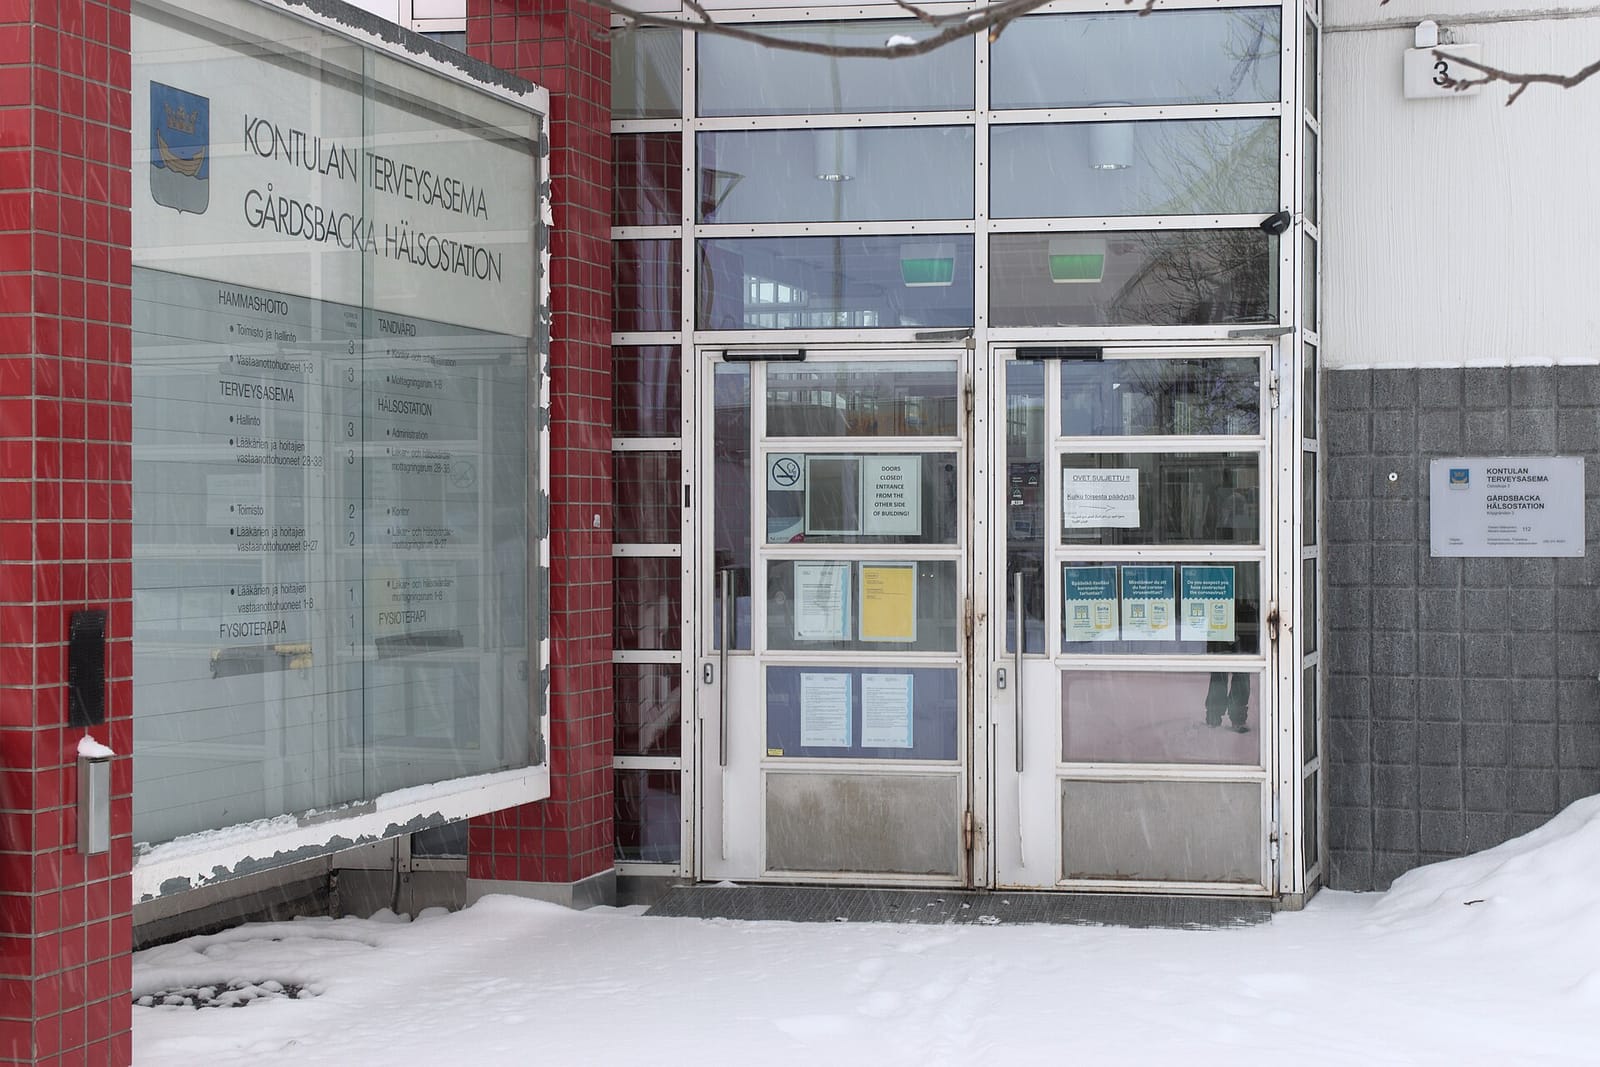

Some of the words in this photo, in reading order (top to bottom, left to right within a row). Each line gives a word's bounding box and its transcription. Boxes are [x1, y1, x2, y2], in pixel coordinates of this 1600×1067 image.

[1433, 61, 1449, 86] 3
[244, 114, 357, 183] KONTULAN
[366, 151, 488, 221] TERVEYSASEMA
[244, 183, 378, 256] GÅRDSBACKA
[385, 218, 502, 283] HÄLSOSTATION
[218, 289, 289, 315] HAMMASHOITO
[236, 324, 264, 339] Toimisto
[266, 330, 273, 341] ja
[274, 329, 297, 344] hallinto
[378, 318, 416, 337] TANDVÅRD
[348, 340, 354, 355] 3
[236, 354, 301, 372] Vastaanottohuoneet
[348, 367, 354, 383] 3
[219, 380, 295, 403] TERVEYSASEMA
[378, 395, 433, 417] HÄLSOSTATION
[236, 414, 261, 427] Hallinto
[348, 421, 354, 437] 3
[391, 427, 429, 440] Administration
[271, 440, 278, 451] ja
[279, 439, 305, 453] hoitajien
[237, 453, 300, 467] vastaanottohuoneet
[348, 449, 354, 465] 3
[1486, 494, 1541, 502] GÅRDSBACKA
[237, 503, 264, 516] Toimisto
[348, 503, 355, 519] 2
[1486, 502, 1545, 510] HÄLSOSTATION
[272, 527, 278, 539] ja
[279, 527, 306, 539] hoitajien
[348, 531, 355, 546] 2
[237, 540, 301, 552] vastaanottohuoneet
[272, 585, 278, 597] ja
[280, 583, 307, 595] hoitajien
[349, 588, 354, 601] 1
[237, 600, 302, 613] vastaanottohuoneet
[349, 615, 354, 628] 1
[378, 608, 427, 626] FYSIOTERAPI
[219, 619, 287, 639] FYSIOTERAPIA
